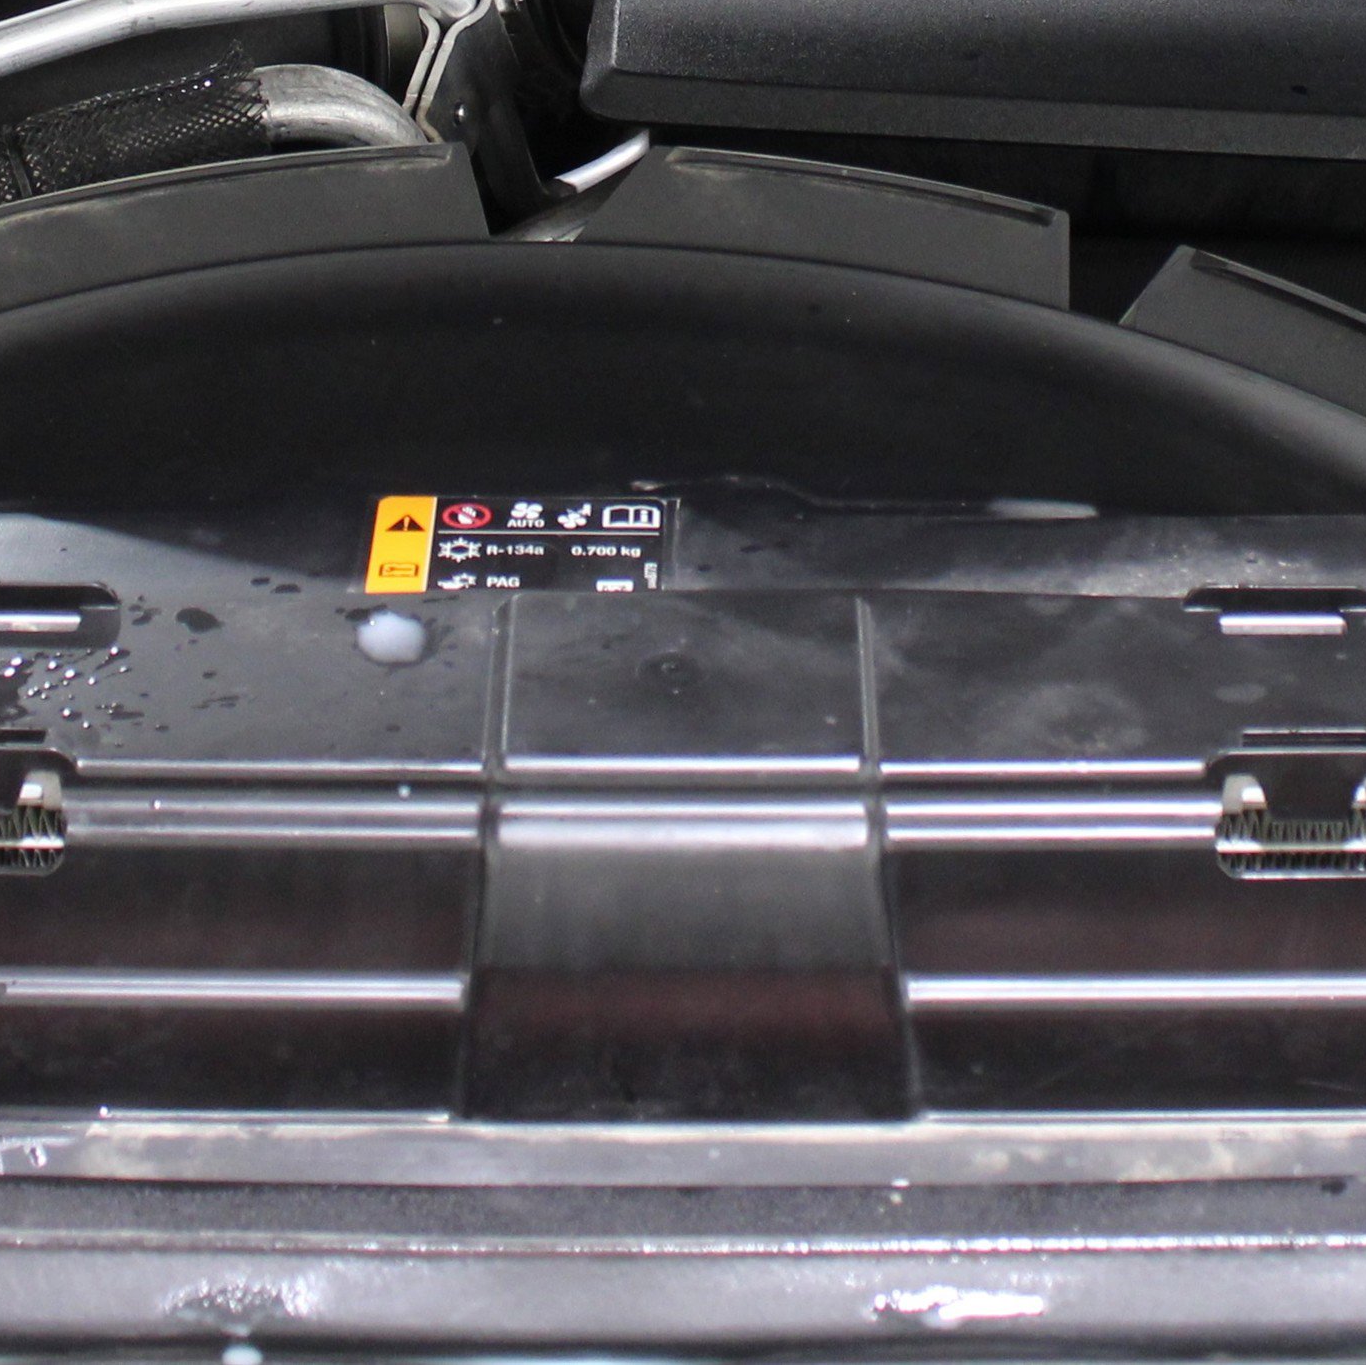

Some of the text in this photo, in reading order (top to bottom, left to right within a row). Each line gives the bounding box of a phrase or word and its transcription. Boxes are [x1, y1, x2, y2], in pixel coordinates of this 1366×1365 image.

[507, 519, 544, 529] AUTO
[487, 544, 641, 559] R-134a 0.700 kg
[487, 576, 520, 588] PAG
